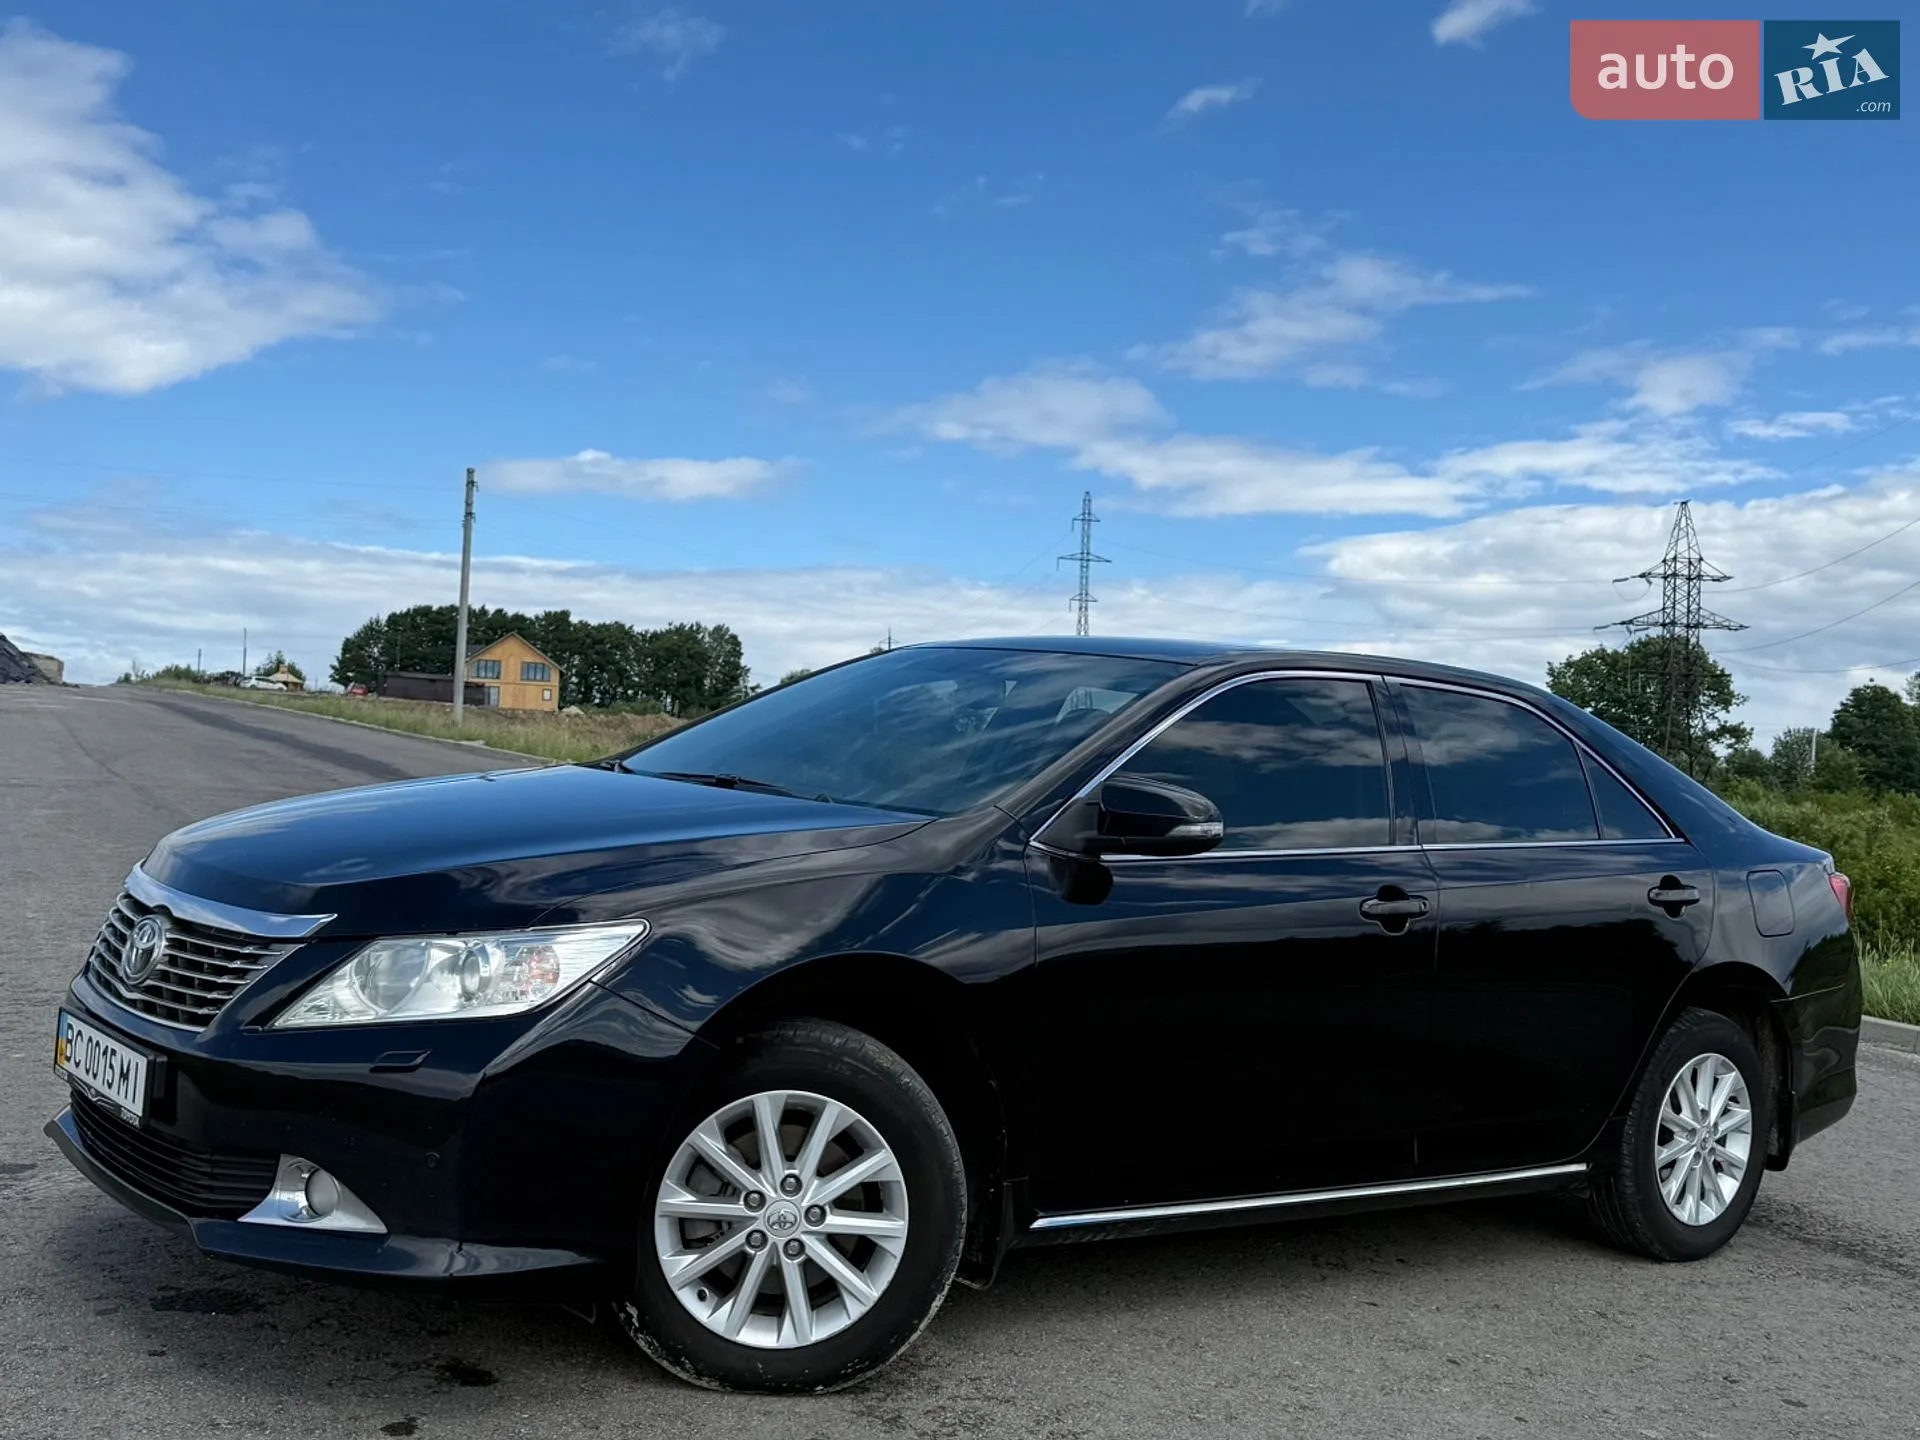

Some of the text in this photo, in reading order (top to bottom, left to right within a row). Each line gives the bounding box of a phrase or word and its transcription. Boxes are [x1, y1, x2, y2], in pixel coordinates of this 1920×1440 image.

[65, 1022, 139, 1104] BC 0015 MI
